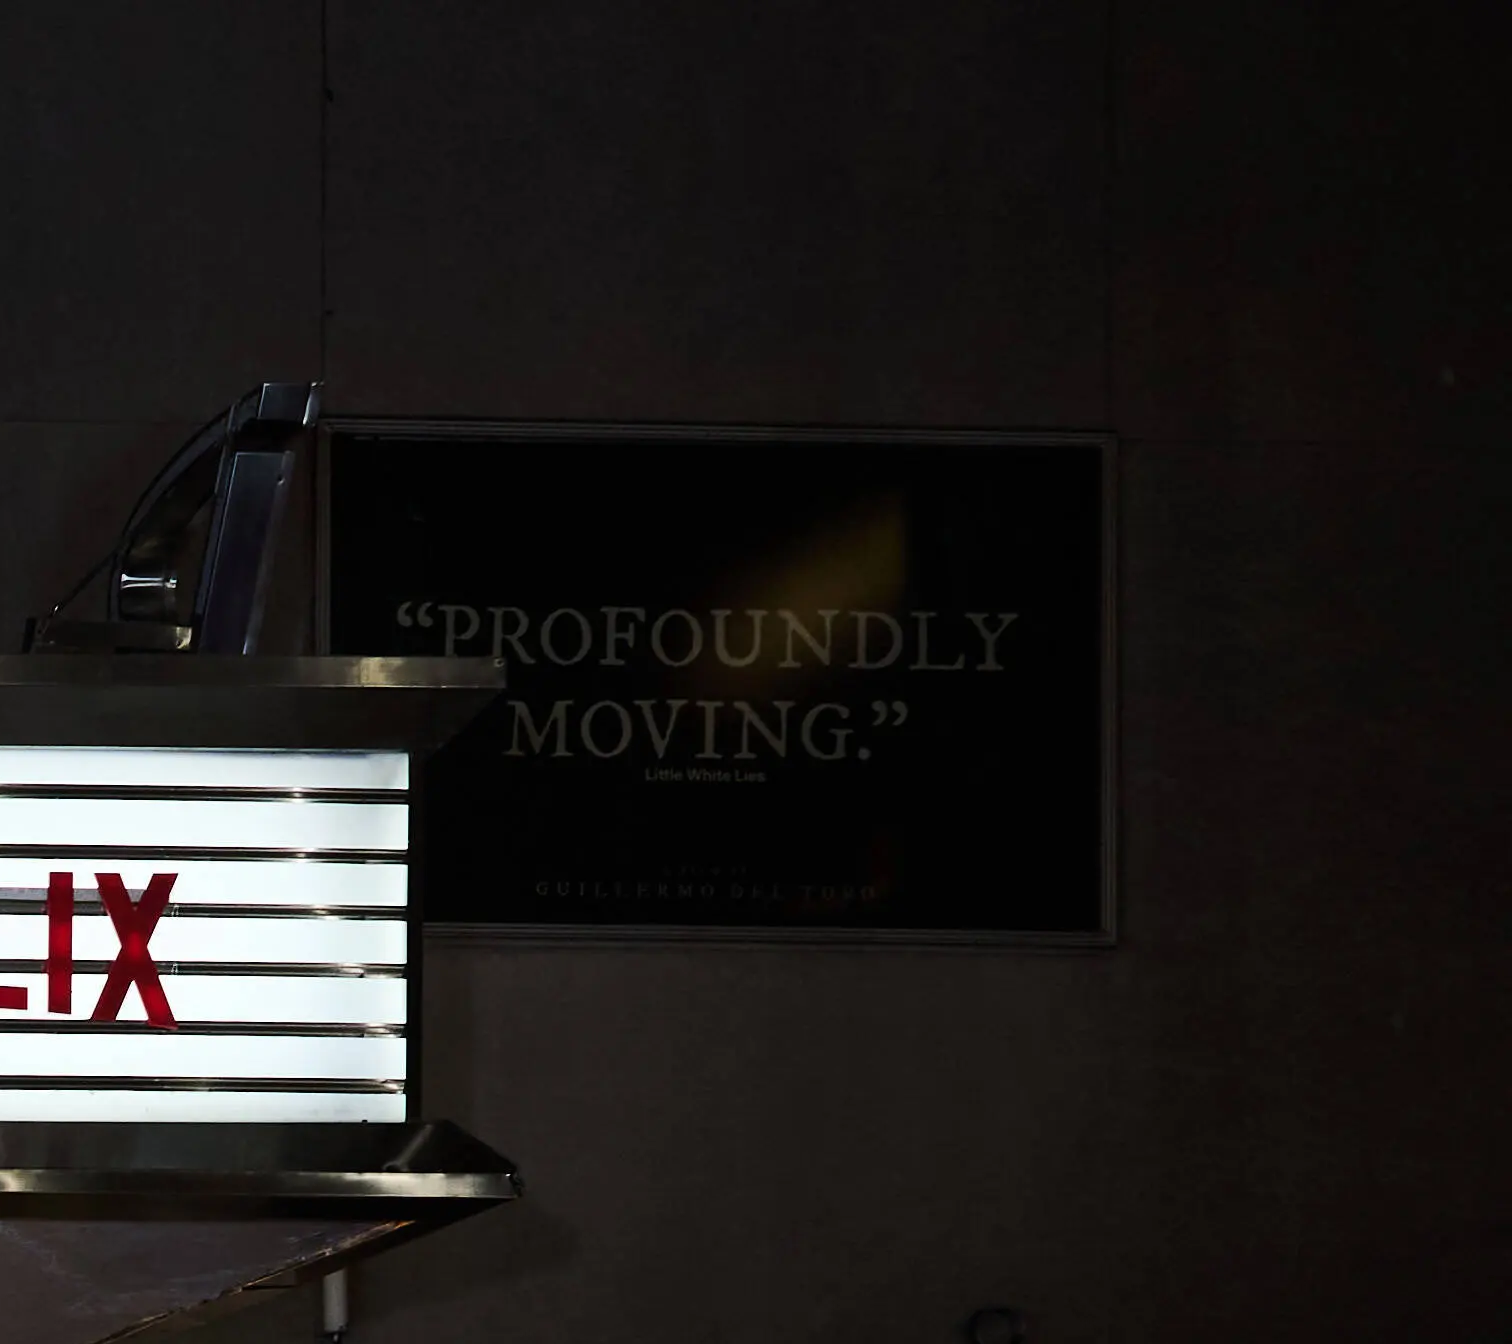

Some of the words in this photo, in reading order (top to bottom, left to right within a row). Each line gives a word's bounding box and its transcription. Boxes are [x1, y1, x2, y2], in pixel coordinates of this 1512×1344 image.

[501, 698, 910, 762] MOVING.”
[643, 767, 682, 783] Little
[685, 768, 732, 784] White
[735, 769, 767, 784] Lies
